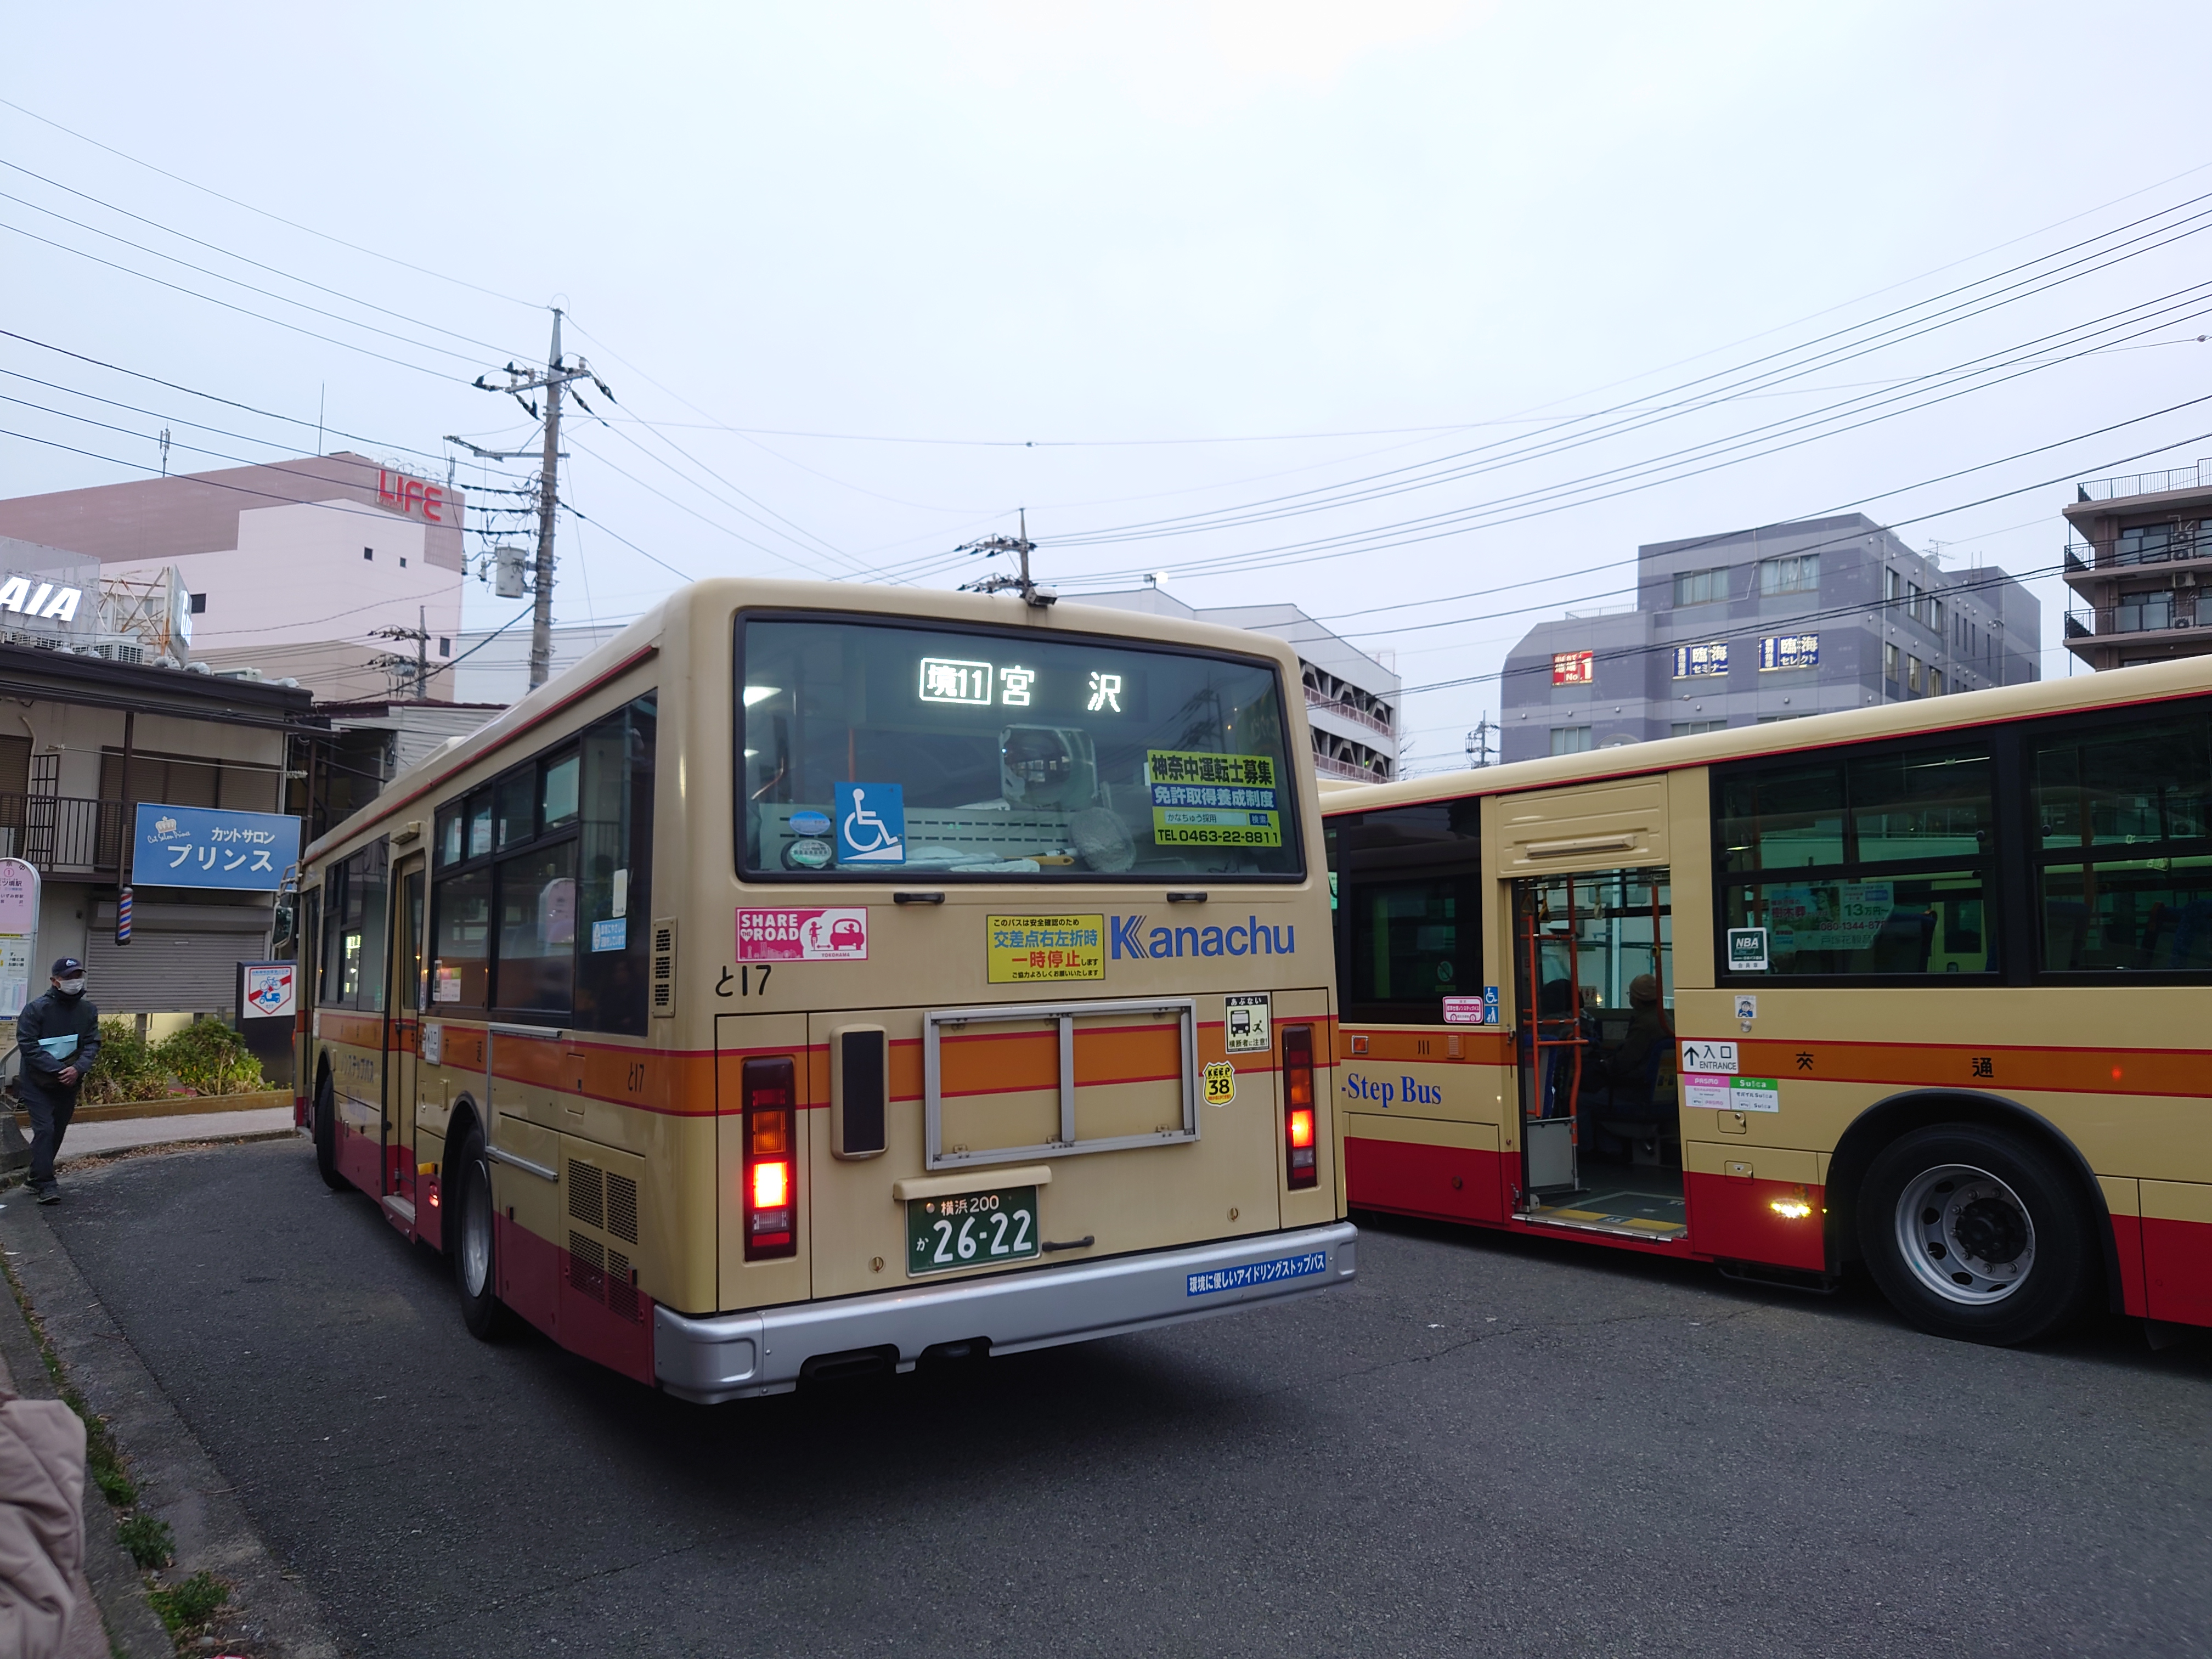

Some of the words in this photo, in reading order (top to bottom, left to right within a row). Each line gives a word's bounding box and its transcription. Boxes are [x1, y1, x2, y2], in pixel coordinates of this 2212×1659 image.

[377, 469, 443, 522] LIFE
[1692, 645, 1727, 663] 臨海
[1780, 636, 1818, 654] 臨海
[1780, 653, 1816, 665] セレクト
[1692, 664, 1728, 674] セミナー
[927, 664, 982, 699] 境11
[1151, 754, 1272, 786] 神奈中運転士募集
[1154, 786, 1274, 808] 免許取得養成制度
[1167, 813, 1217, 823] かなちゅう採用
[211, 827, 275, 844] カットサロン
[1158, 830, 1177, 841] TEL
[1180, 830, 1278, 844] 0463-22-8811
[167, 843, 273, 872] プリンス
[741, 913, 798, 927] SHARE
[994, 919, 1079, 927] このバスは安全確認のため
[754, 927, 799, 941] ROAD
[994, 929, 1098, 949] 交差点右左折時
[1110, 915, 1295, 960] Kanachu
[1736, 937, 1759, 947] NBA
[1012, 950, 1098, 968] 一時停止します
[715, 965, 772, 997] と17
[1012, 969, 1098, 979] ご協力よろしくお願いいたします
[1231, 997, 1262, 1006] あぶない
[1703, 1045, 1732, 1059] 入口
[1796, 1051, 1814, 1070] 交
[1207, 1067, 1231, 1077] KEEP
[1699, 1061, 1737, 1070] ENTRANCE
[1972, 1057, 1994, 1078] 通
[628, 1062, 645, 1093] と17
[1209, 1079, 1230, 1096] 38
[1400, 1076, 1442, 1105] Bus
[941, 1194, 999, 1216] 横浜200
[916, 1237, 929, 1252] か
[933, 1209, 1032, 1263] 26-22
[1189, 1253, 1325, 1294] 環境に優しいアイドリングストップバス
